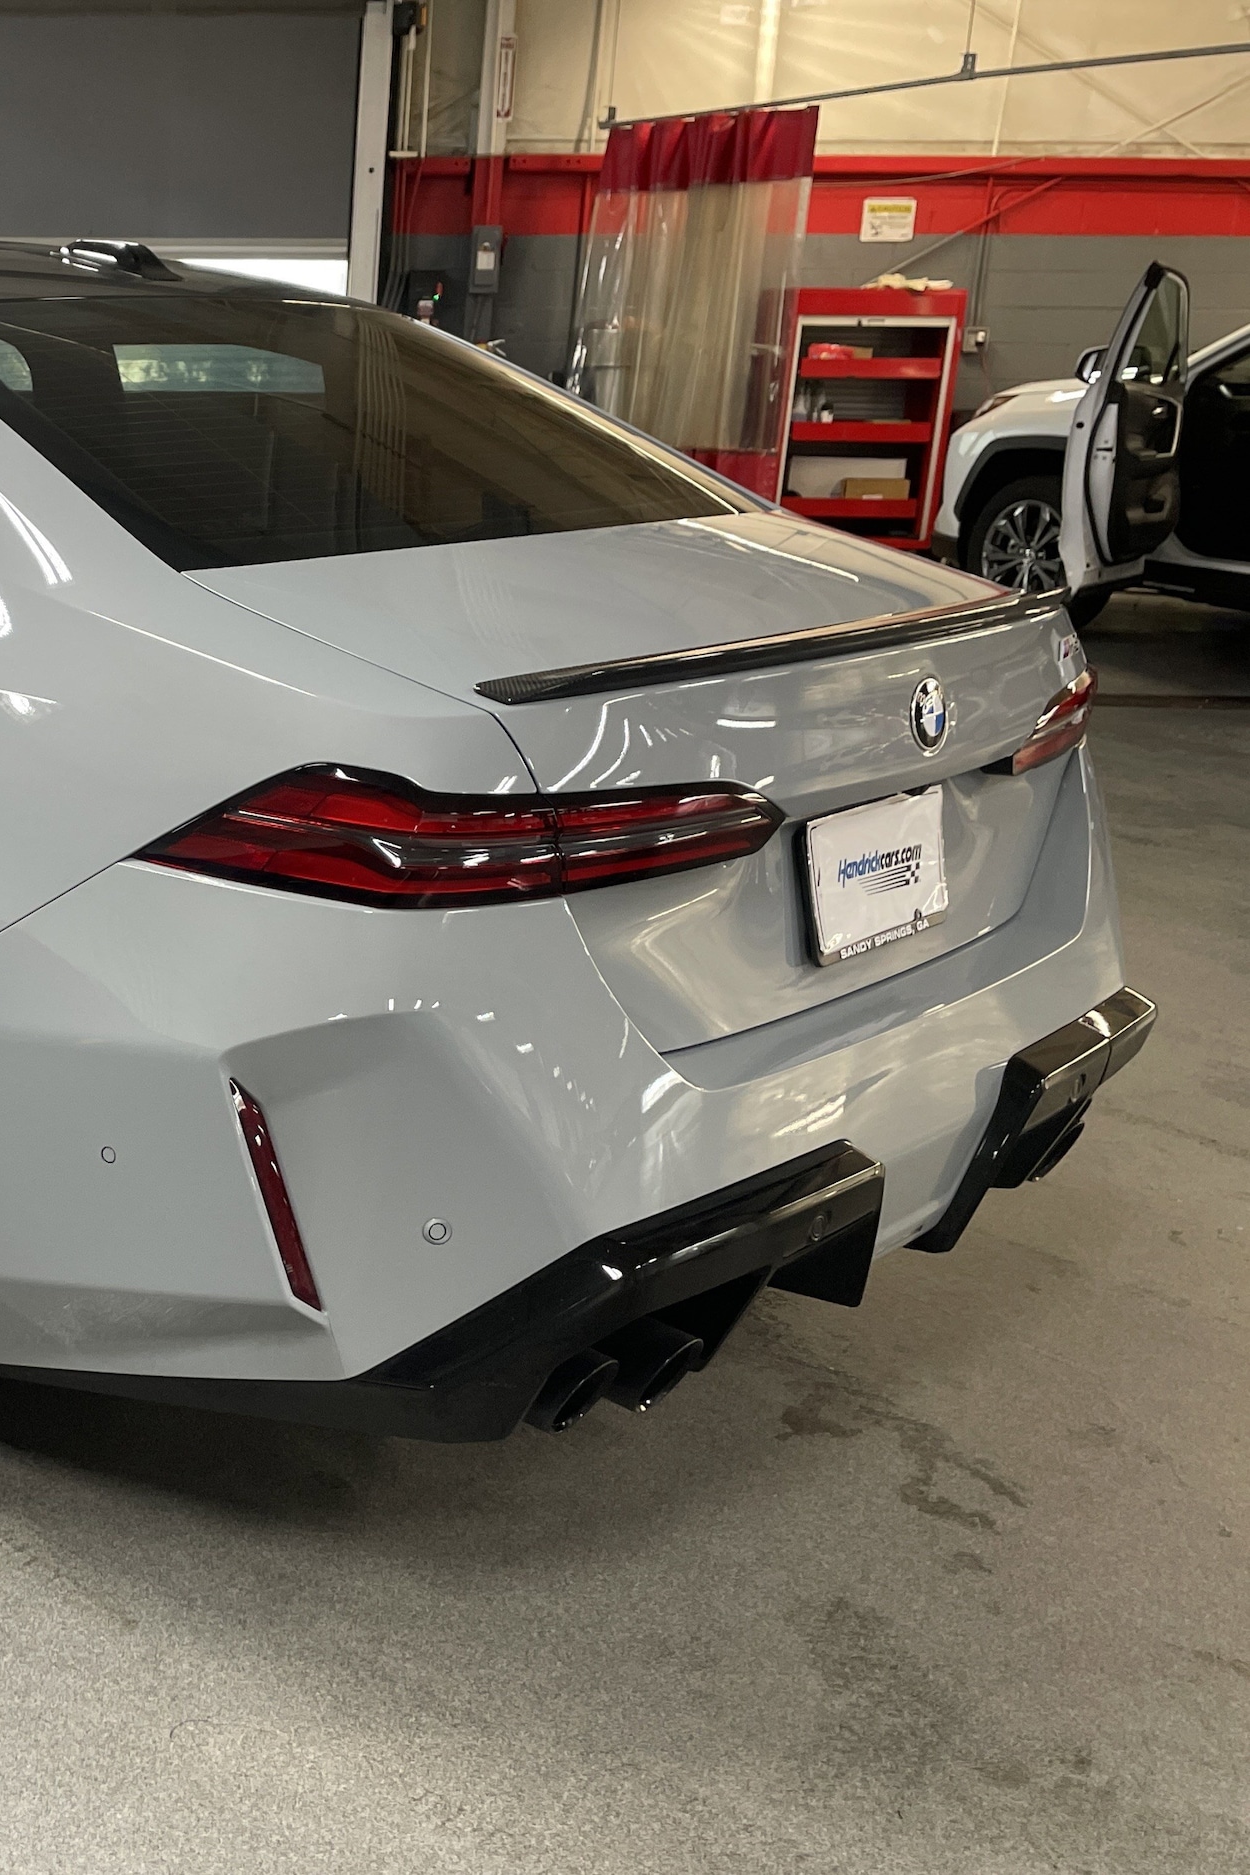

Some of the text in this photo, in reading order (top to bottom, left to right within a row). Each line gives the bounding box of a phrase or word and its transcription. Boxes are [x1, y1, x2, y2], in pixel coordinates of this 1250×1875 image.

[838, 844, 922, 888] Hendrickcars.com
[840, 918, 930, 959] SANDY SPRINGS, GA
